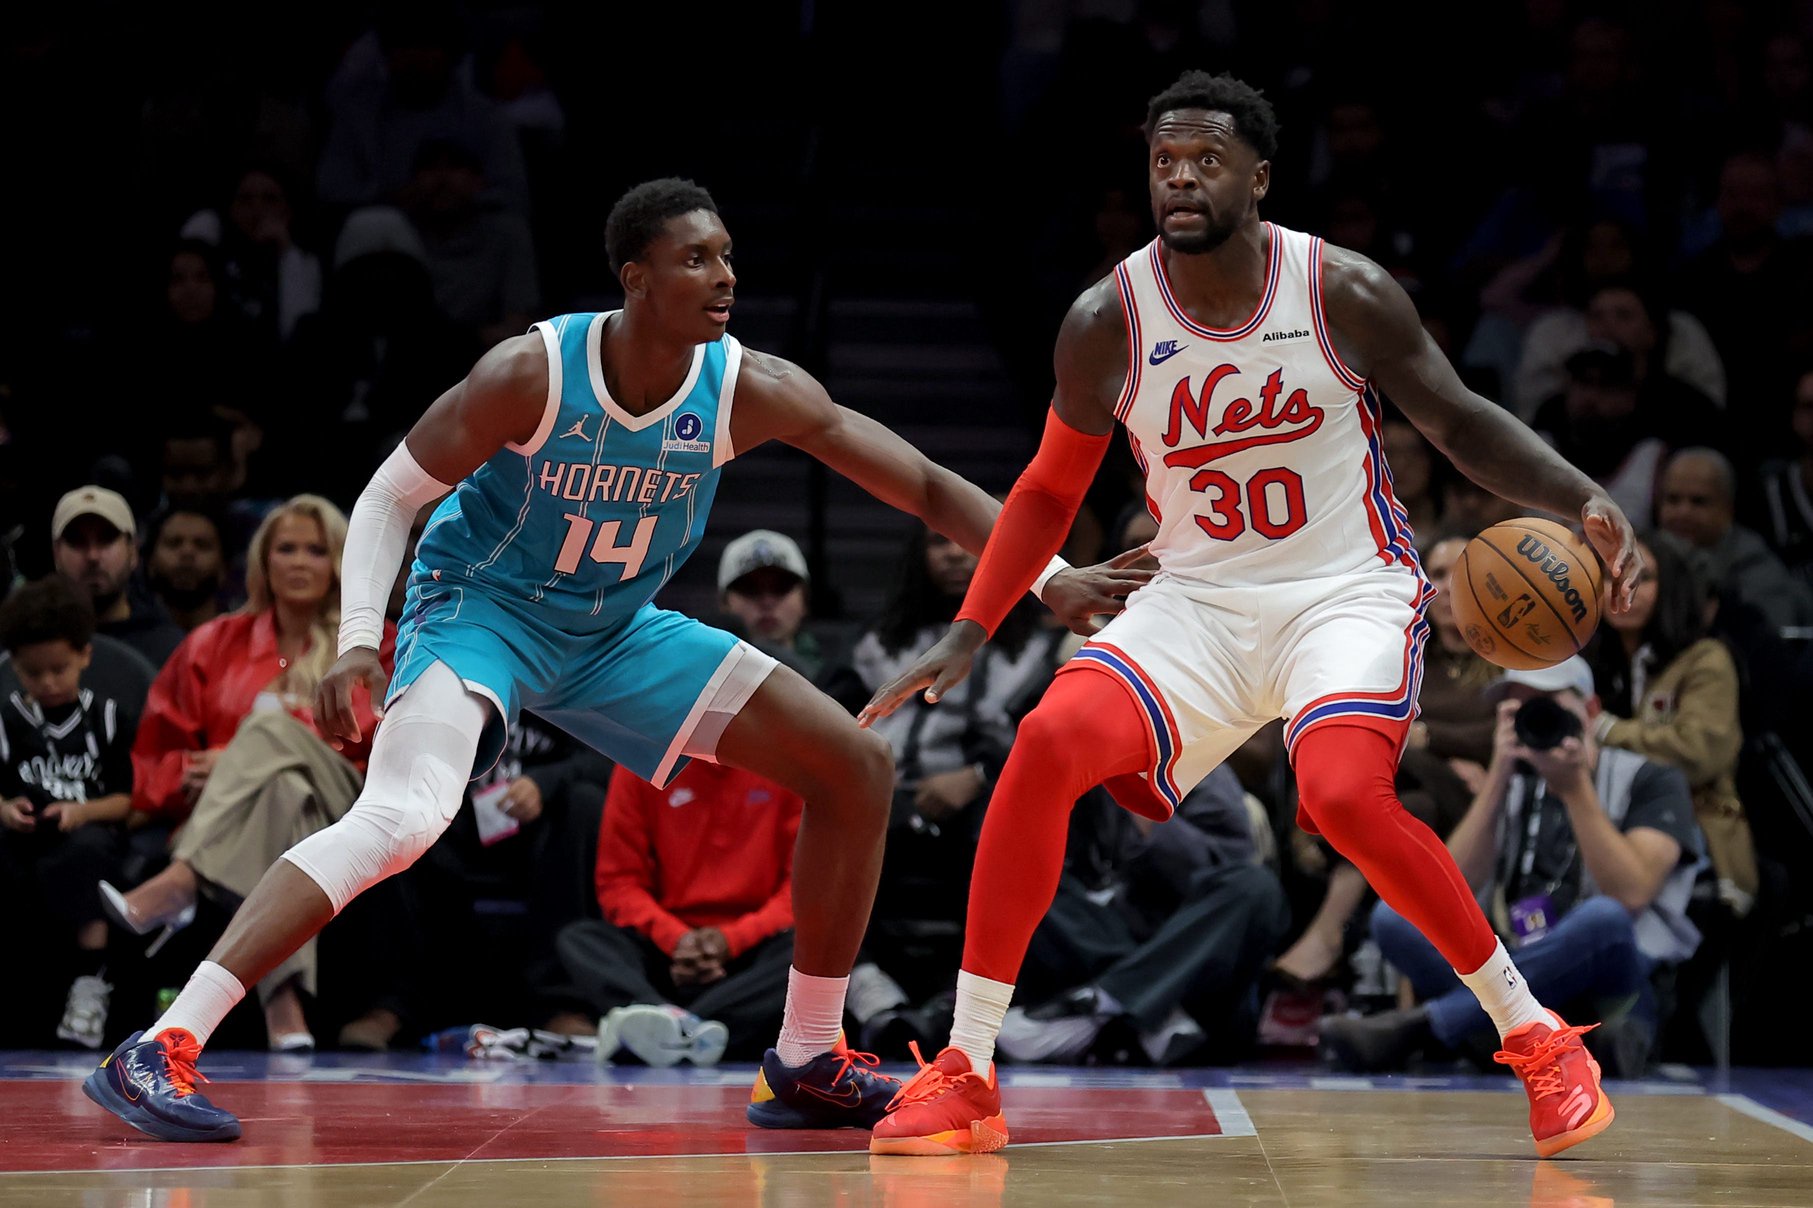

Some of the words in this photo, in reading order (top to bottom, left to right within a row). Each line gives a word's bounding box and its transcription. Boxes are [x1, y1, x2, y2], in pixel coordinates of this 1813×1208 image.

[1153, 340, 1178, 356] NIKE
[1262, 330, 1310, 342] Alibaba
[1161, 363, 1325, 447] Nets
[663, 441, 682, 450] Judi
[683, 442, 709, 451] Health
[539, 461, 701, 503] HORNETS
[1188, 466, 1308, 542] 30
[554, 513, 659, 582] 14
[1516, 534, 1588, 625] Wilson
